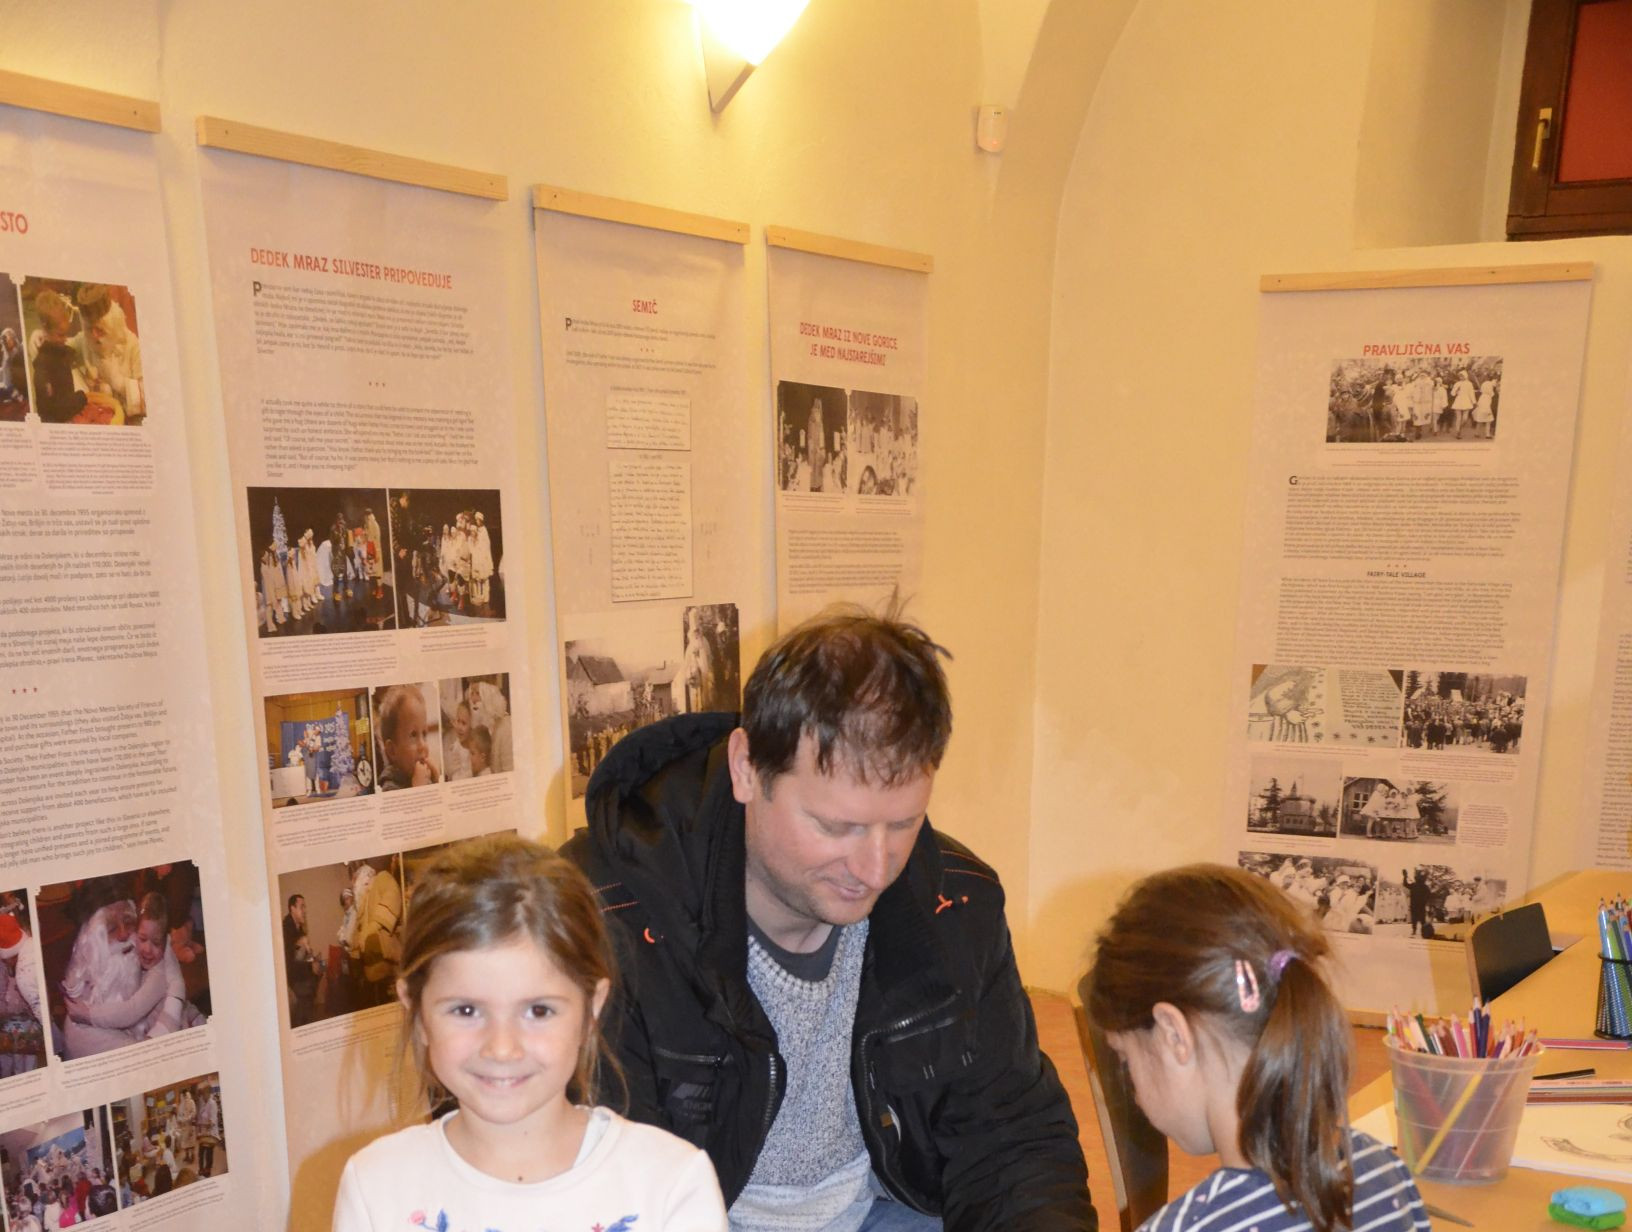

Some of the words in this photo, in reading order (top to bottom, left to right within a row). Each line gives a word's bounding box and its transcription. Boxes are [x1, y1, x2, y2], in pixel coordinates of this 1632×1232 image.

[251, 248, 289, 269] DEDEK
[294, 254, 328, 273] MRAZ
[332, 259, 381, 281] SILVESTER
[383, 267, 452, 289] PRIPOVEDUJE
[632, 299, 658, 314] SEMIČ
[800, 322, 820, 337] DEDEK
[822, 327, 842, 341] MRAZ
[844, 330, 851, 343] IZ
[853, 332, 871, 346] NOVE
[810, 343, 818, 357] JE
[820, 345, 836, 359] MED
[1363, 341, 1441, 356] PRAVLJIČNA
[1447, 342, 1470, 355] VAS
